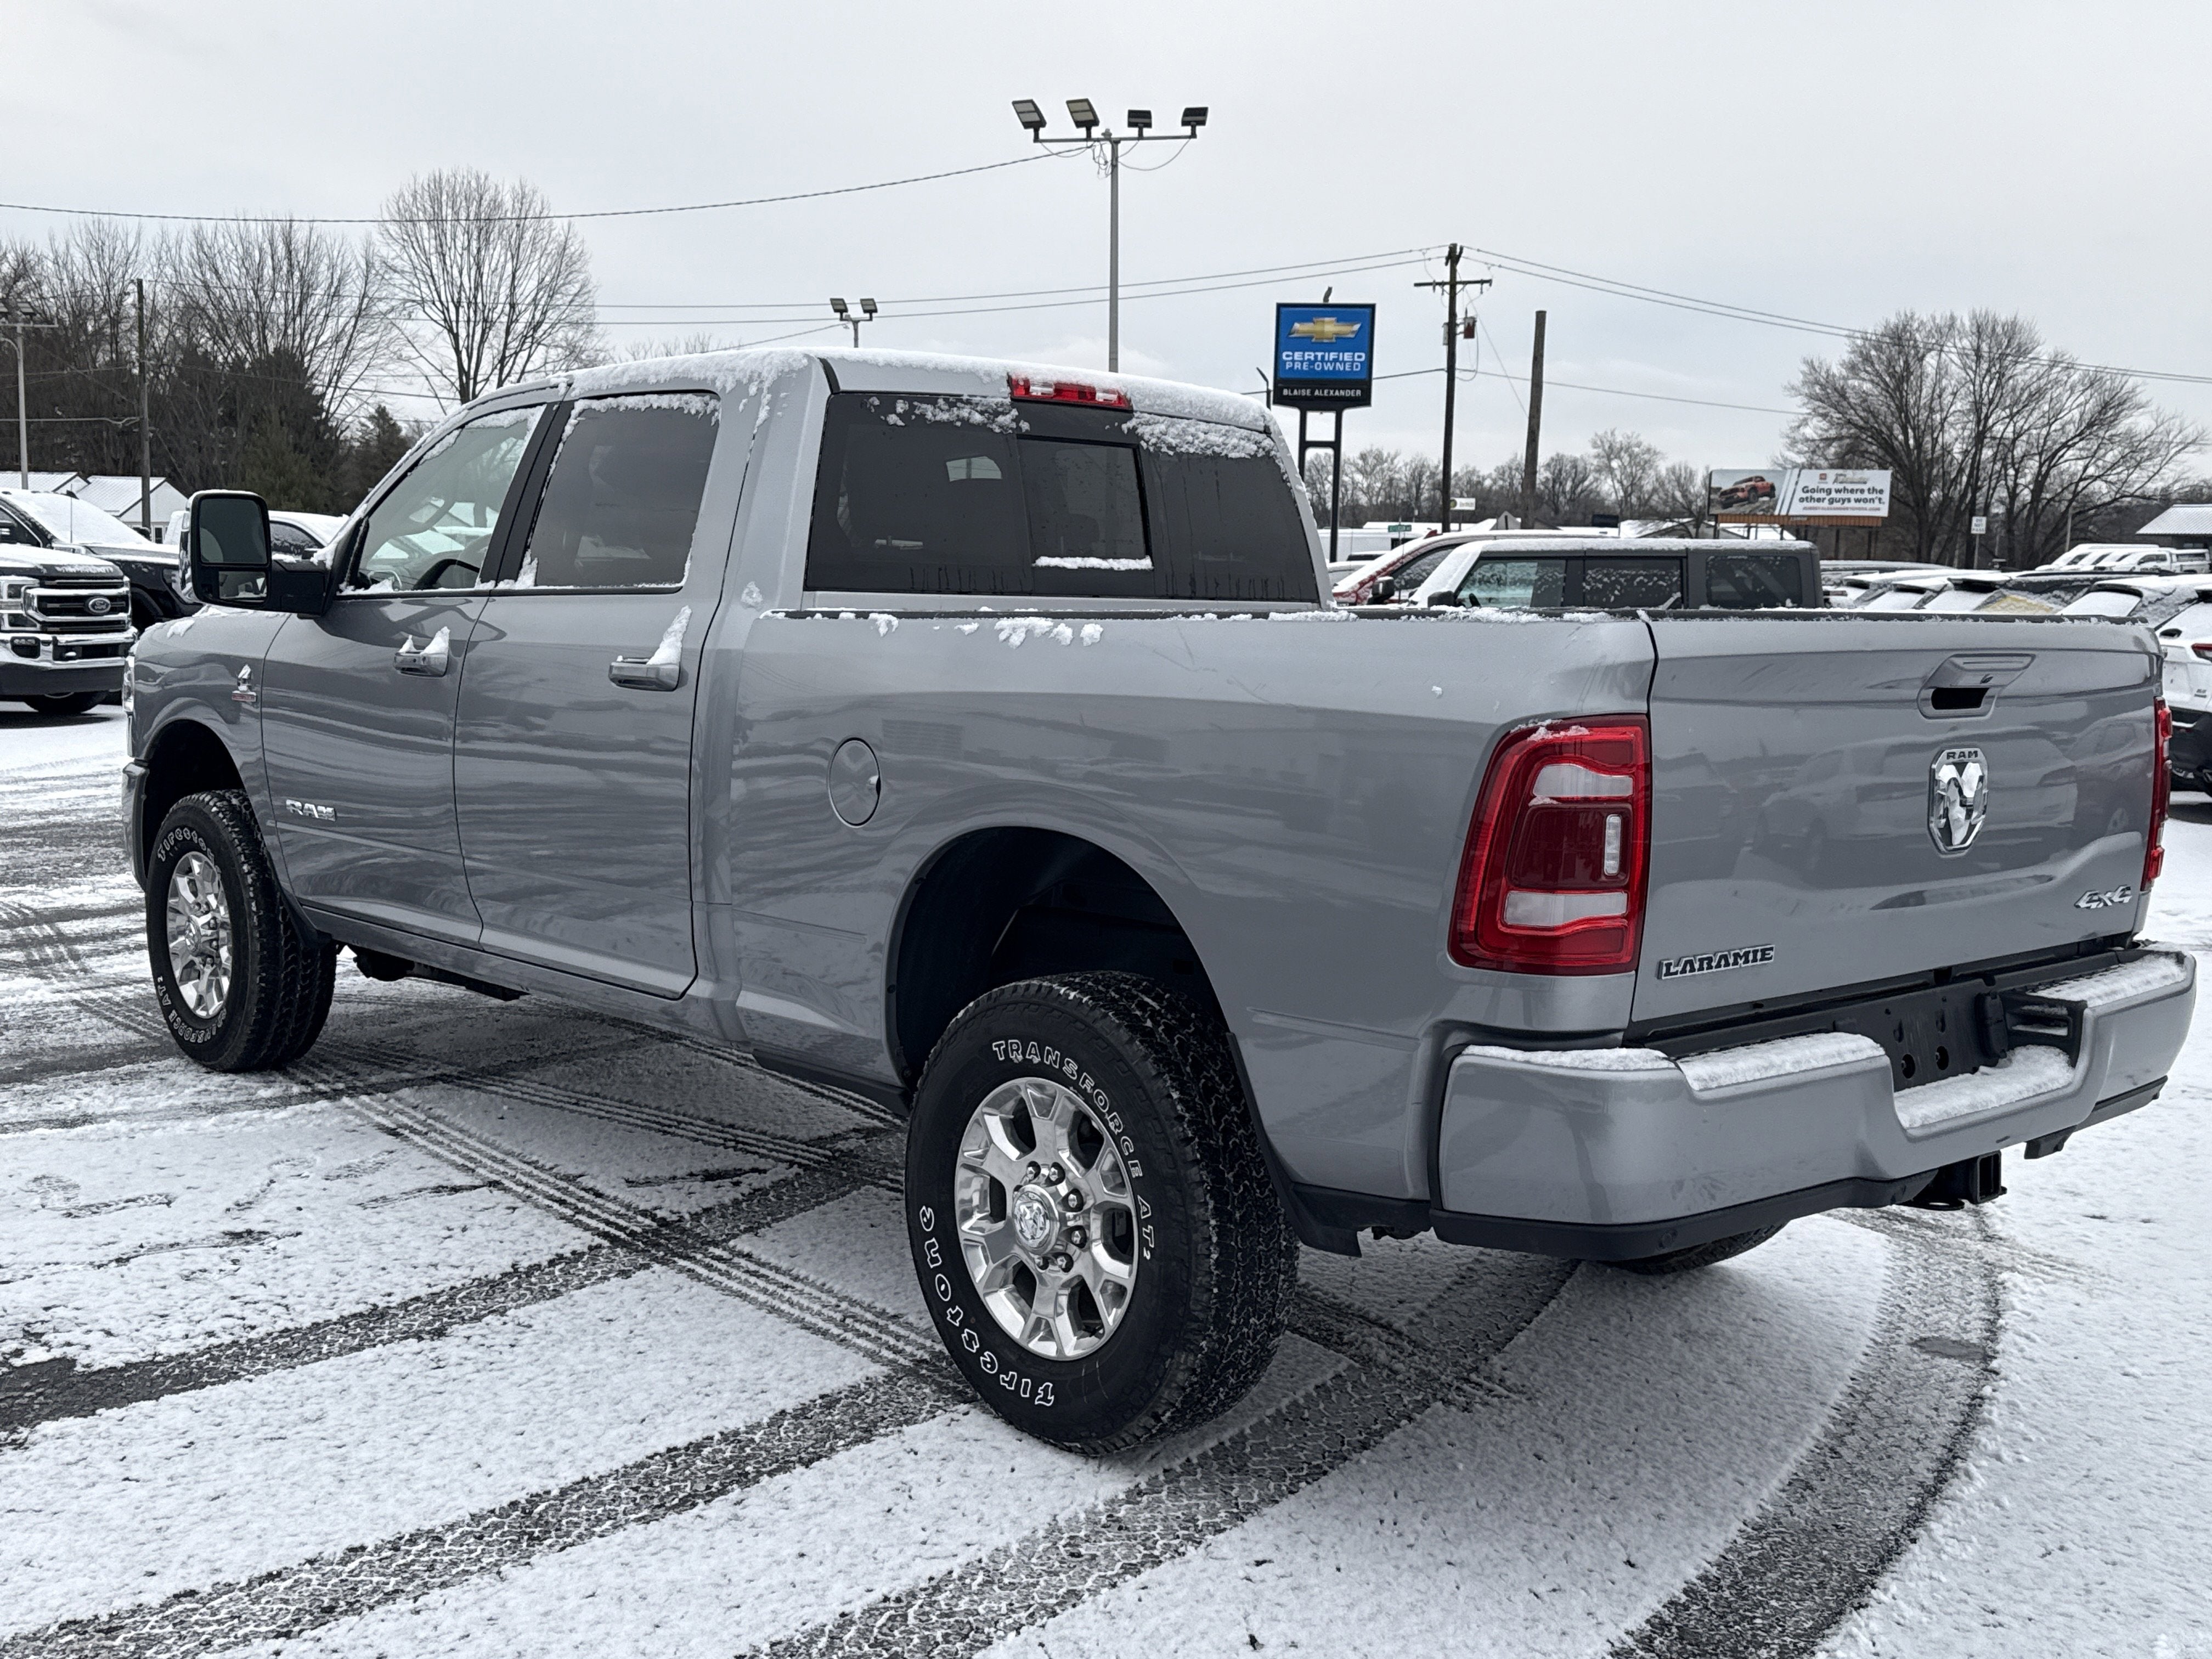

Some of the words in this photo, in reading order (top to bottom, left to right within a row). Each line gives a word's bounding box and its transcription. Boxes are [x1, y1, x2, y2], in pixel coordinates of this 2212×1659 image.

[1282, 351, 1366, 362] CERTIFIED
[1285, 362, 1361, 371] PRE-OWNED
[1314, 388, 1362, 397] ALEXANDER
[1802, 486, 1832, 496] Going
[1834, 486, 1865, 494] where
[1867, 486, 1884, 494] the
[1798, 495, 1826, 503] other
[1827, 496, 1852, 505] guys
[1853, 495, 1885, 505] won't.
[1946, 750, 1978, 760] RAM
[285, 799, 336, 822] RAM
[1660, 945, 1775, 979] LARAMIE
[992, 1039, 1143, 1179] TRANSFORCE
[919, 1205, 1054, 1407] Firestone
